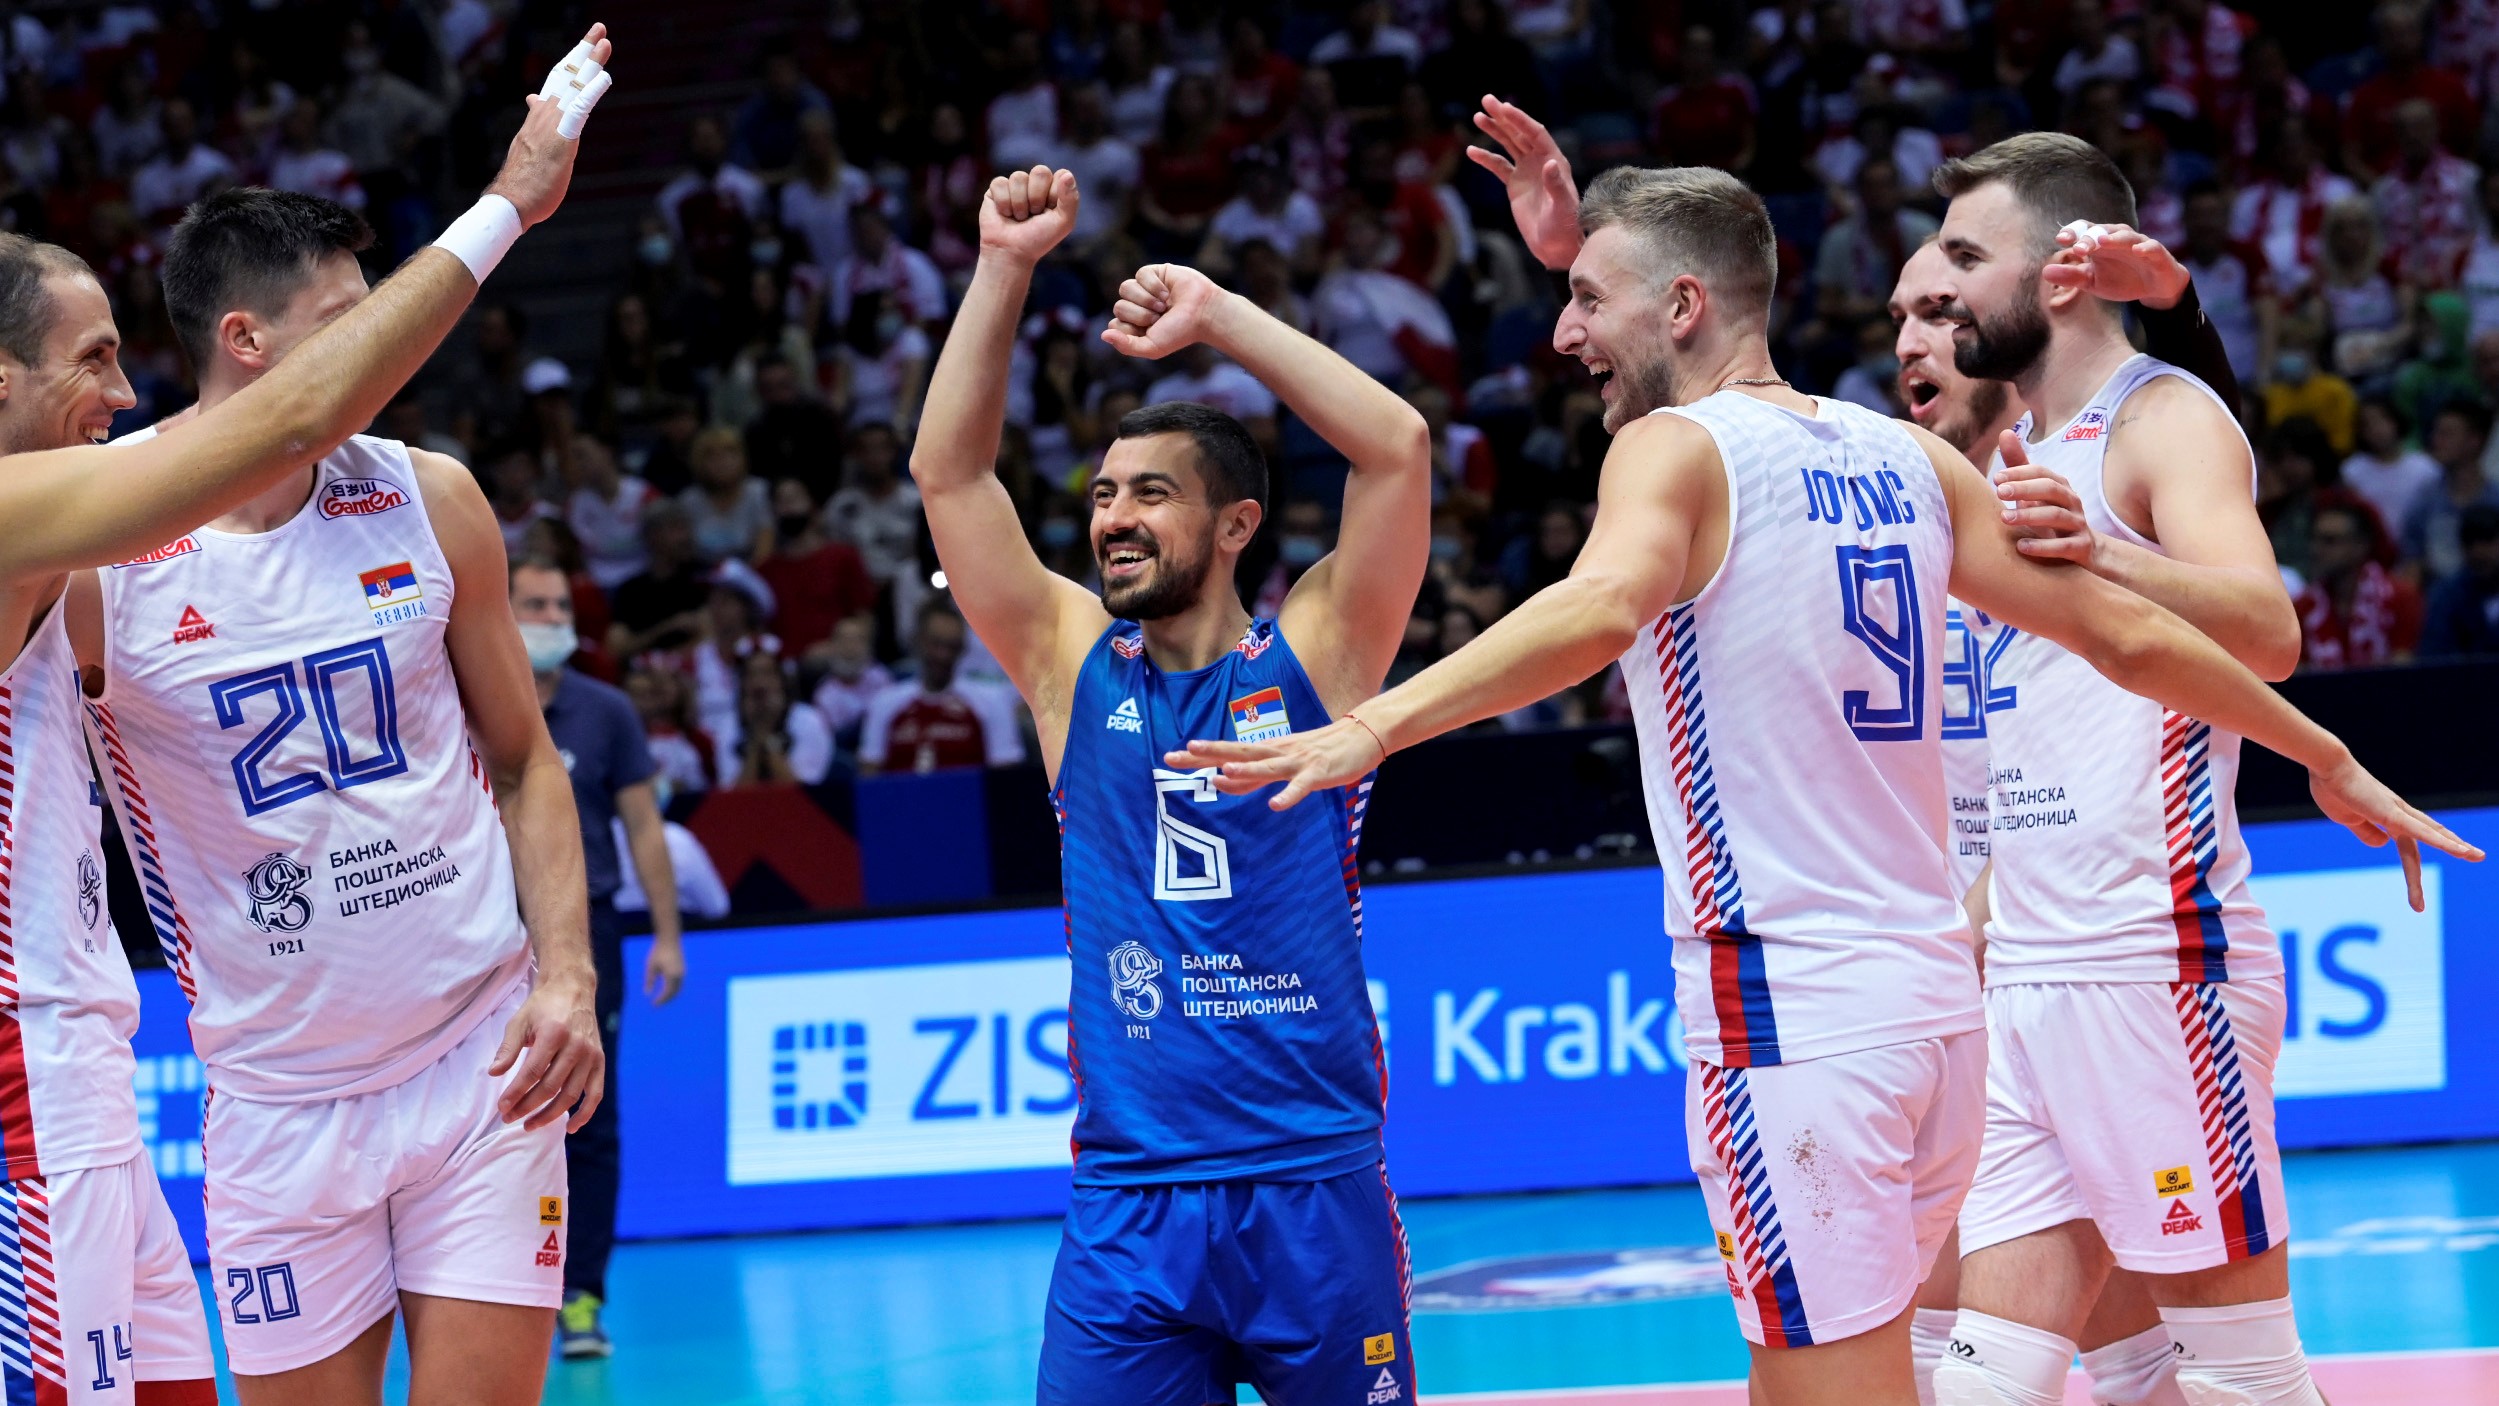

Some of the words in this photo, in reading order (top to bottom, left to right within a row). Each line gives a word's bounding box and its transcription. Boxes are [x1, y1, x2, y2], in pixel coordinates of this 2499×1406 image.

[330, 481, 377, 498] 百岁山
[374, 601, 427, 626] SERBIA
[173, 623, 216, 645] PEAK
[1835, 544, 1925, 741] 9
[208, 636, 409, 817] 20
[1106, 715, 1143, 734] PEAK
[1953, 797, 1989, 812] БАНК
[1153, 766, 1233, 901] 6
[330, 838, 398, 868] БАНКА
[334, 845, 446, 892] ПОШТАНСКА
[339, 864, 461, 917] ШТЕДИОНИЦА
[268, 938, 305, 956] 1921
[1181, 954, 1243, 971] БАНКА
[1182, 973, 1302, 993] ПОШТАНСКА
[2282, 925, 2388, 1040] IS
[1184, 995, 1318, 1019] ШТЕДИОНИЦА
[1126, 1024, 1151, 1040] 1921
[911, 1007, 1080, 1121] ZIS
[2158, 1182, 2190, 1194] MOZZART
[2161, 1215, 2203, 1236] PEAK
[535, 1251, 561, 1267] PEAK
[228, 1261, 301, 1325] 20
[1367, 1384, 1402, 1405] PEAK
